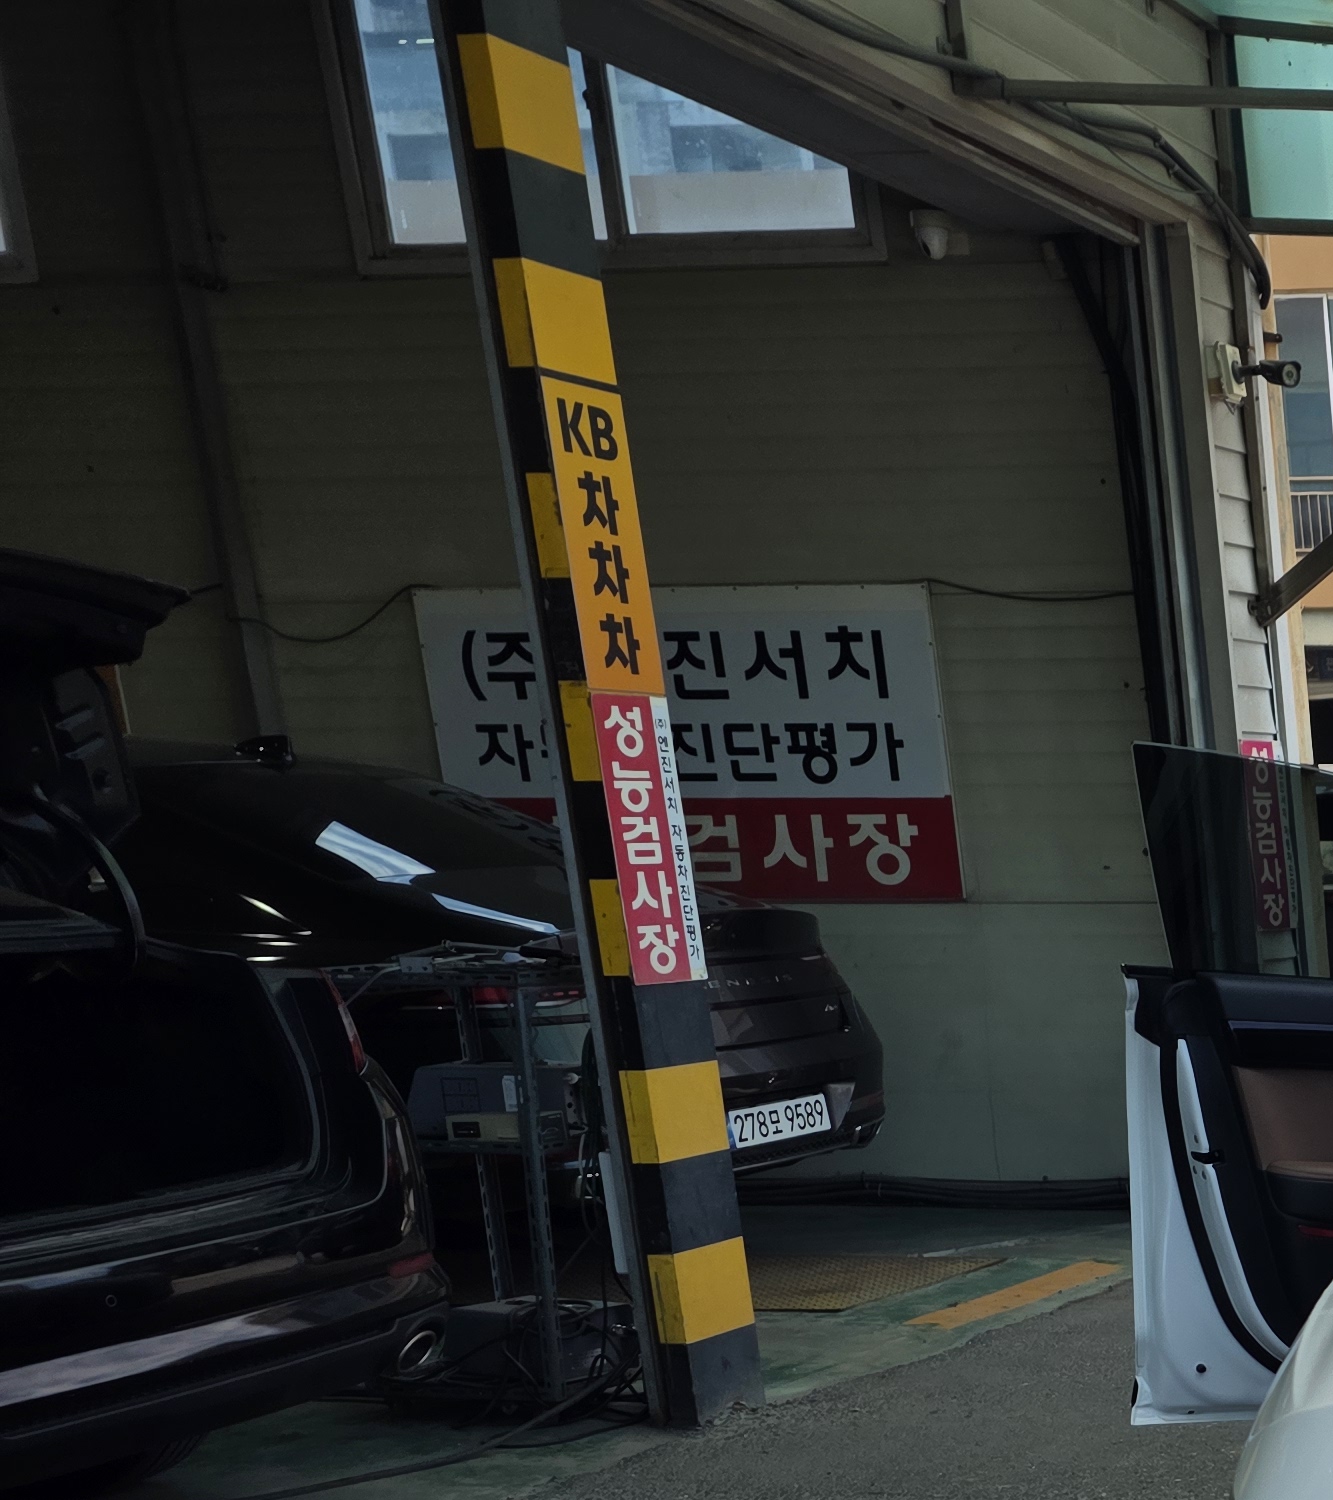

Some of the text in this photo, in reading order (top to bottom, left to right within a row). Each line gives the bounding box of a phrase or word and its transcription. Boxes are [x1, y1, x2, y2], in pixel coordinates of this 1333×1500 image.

[556, 396, 640, 676] KB 차차차
[461, 625, 891, 701] (주진서치
[474, 721, 905, 784] 자진단평가
[603, 704, 680, 975] 성능검사장
[688, 812, 919, 886] 검사장
[1250, 746, 1285, 927] 성능검사장
[671, 823, 701, 961] 자동차진단평가
[733, 1099, 824, 1142] 278모 9589
